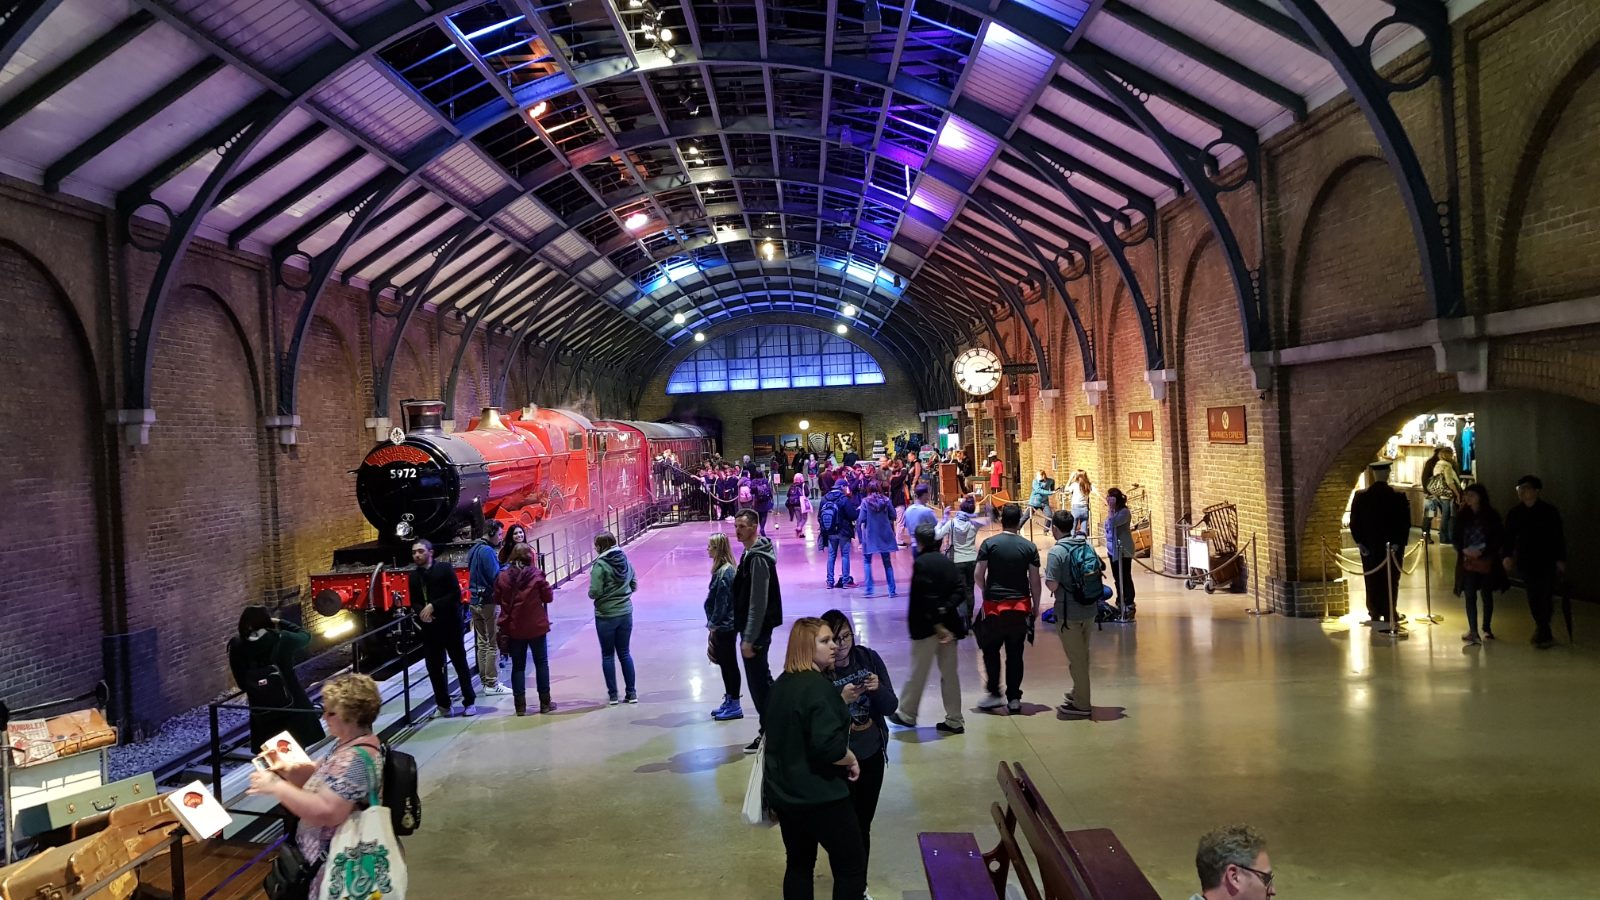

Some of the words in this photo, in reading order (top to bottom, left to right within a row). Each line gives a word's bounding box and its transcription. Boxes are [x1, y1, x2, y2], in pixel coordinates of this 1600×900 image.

[1210, 431, 1229, 439] HOGWARTS
[1229, 431, 1244, 439] EXPRESS
[390, 468, 417, 479] 5972
